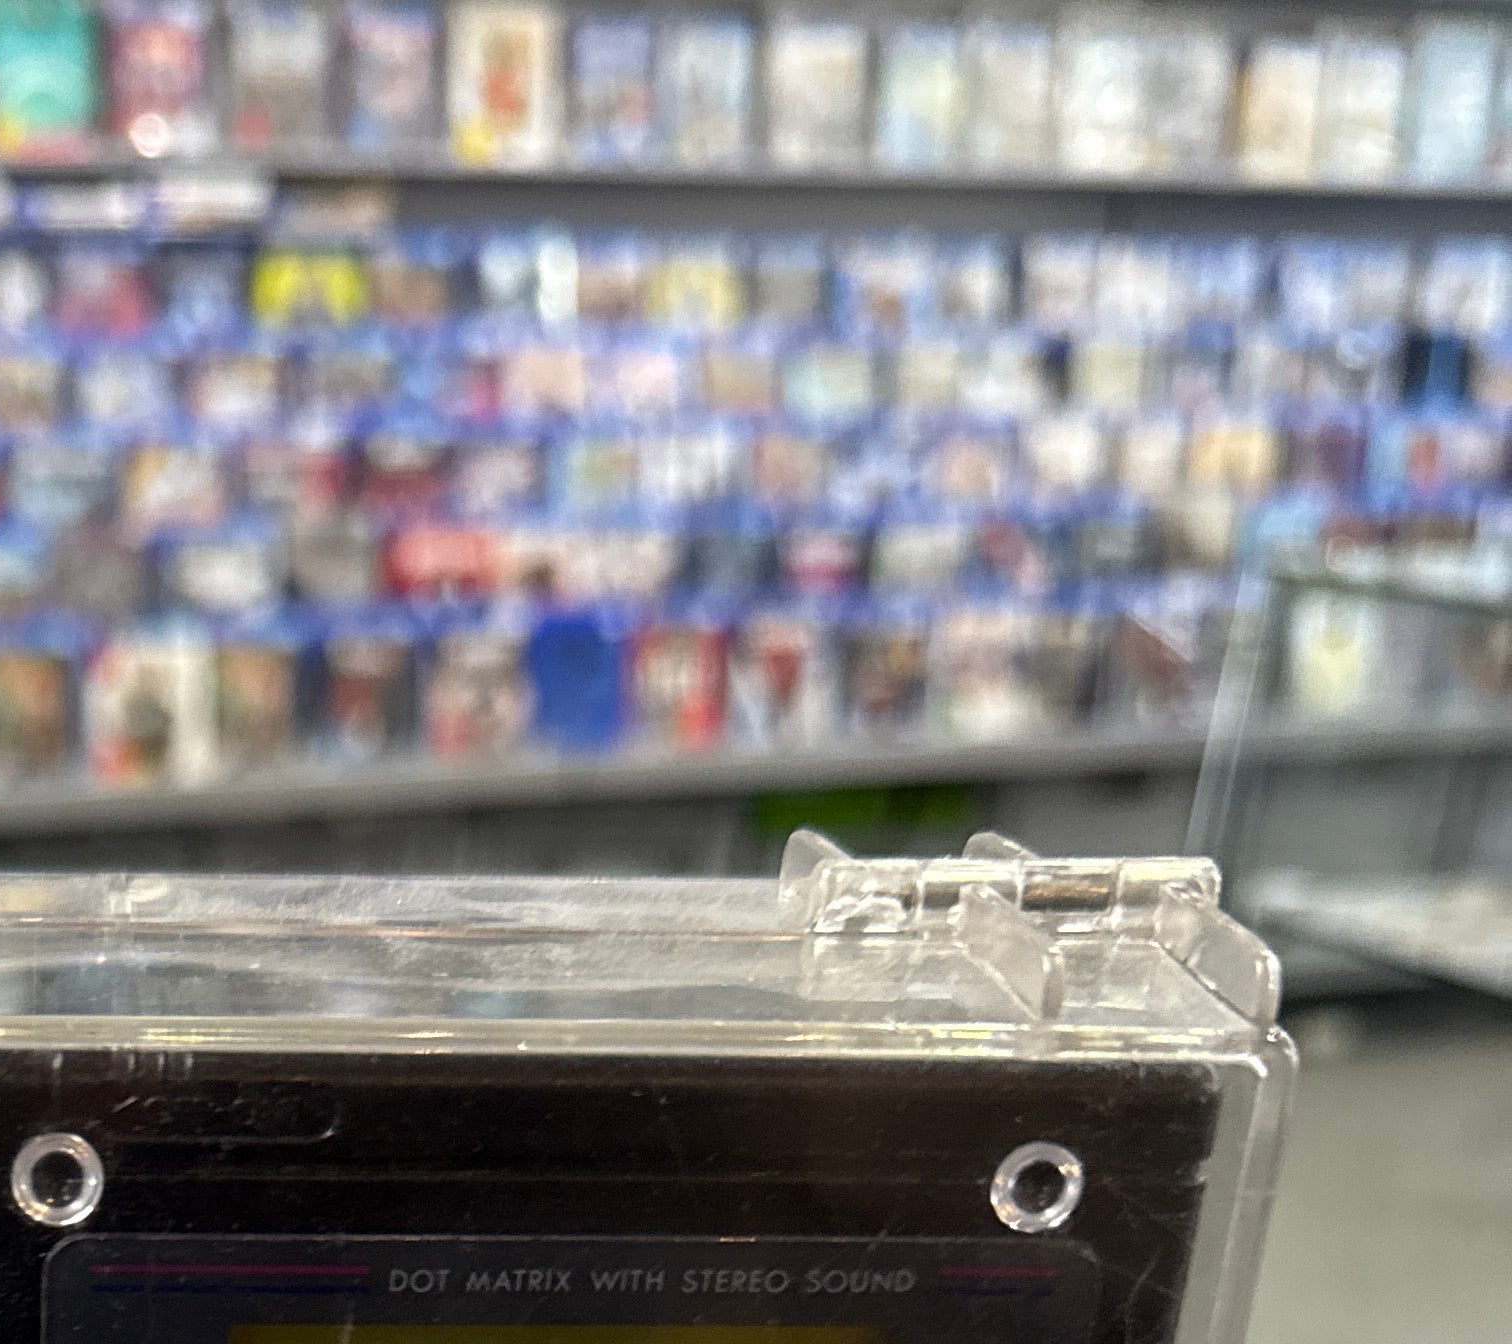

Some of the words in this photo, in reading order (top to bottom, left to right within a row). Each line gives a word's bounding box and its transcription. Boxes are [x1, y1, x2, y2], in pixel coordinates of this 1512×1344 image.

[389, 1268, 452, 1294] DOT
[465, 1268, 573, 1294] MATRIX
[589, 1268, 665, 1294] WITH
[681, 1268, 789, 1294] STEREO
[805, 1268, 916, 1294] SOUND
